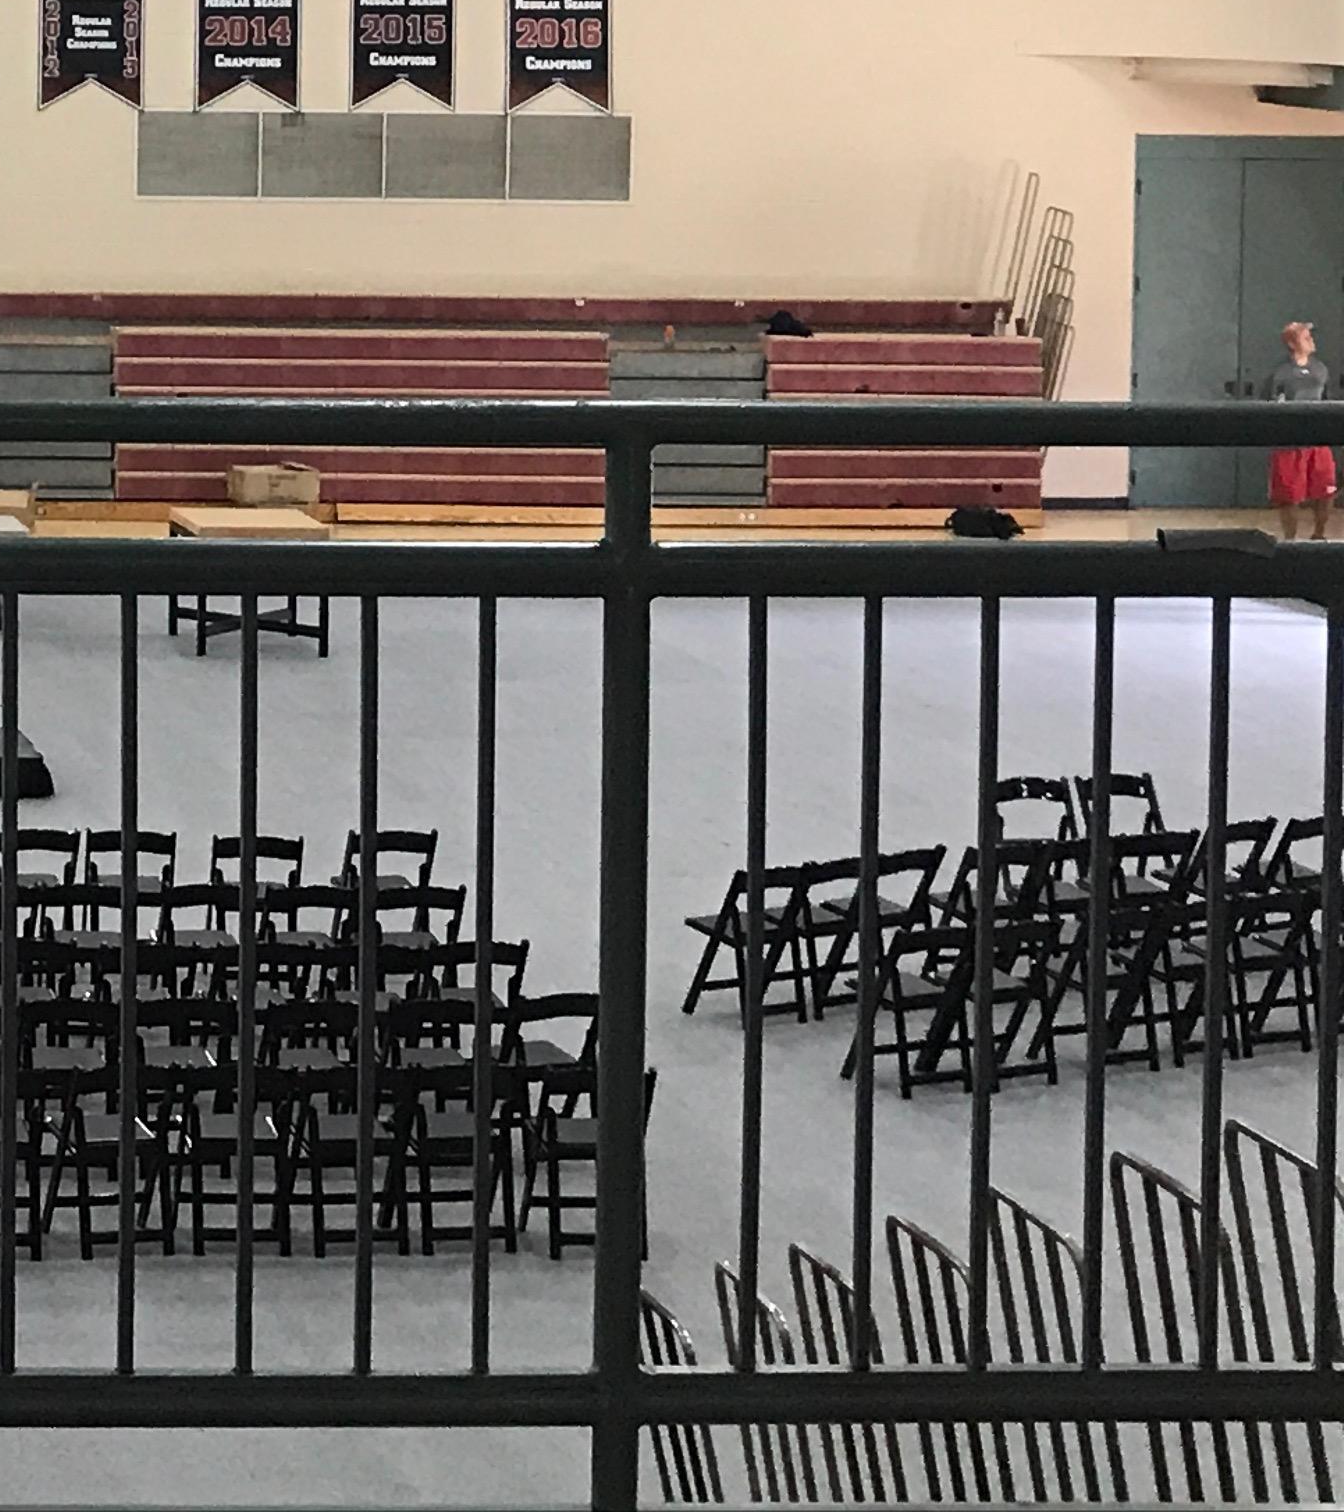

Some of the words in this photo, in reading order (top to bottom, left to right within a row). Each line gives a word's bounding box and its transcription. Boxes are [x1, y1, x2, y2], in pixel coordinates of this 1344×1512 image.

[205, 16, 291, 46] 2014
[360, 14, 446, 44] 2015
[516, 18, 601, 48] 2016
